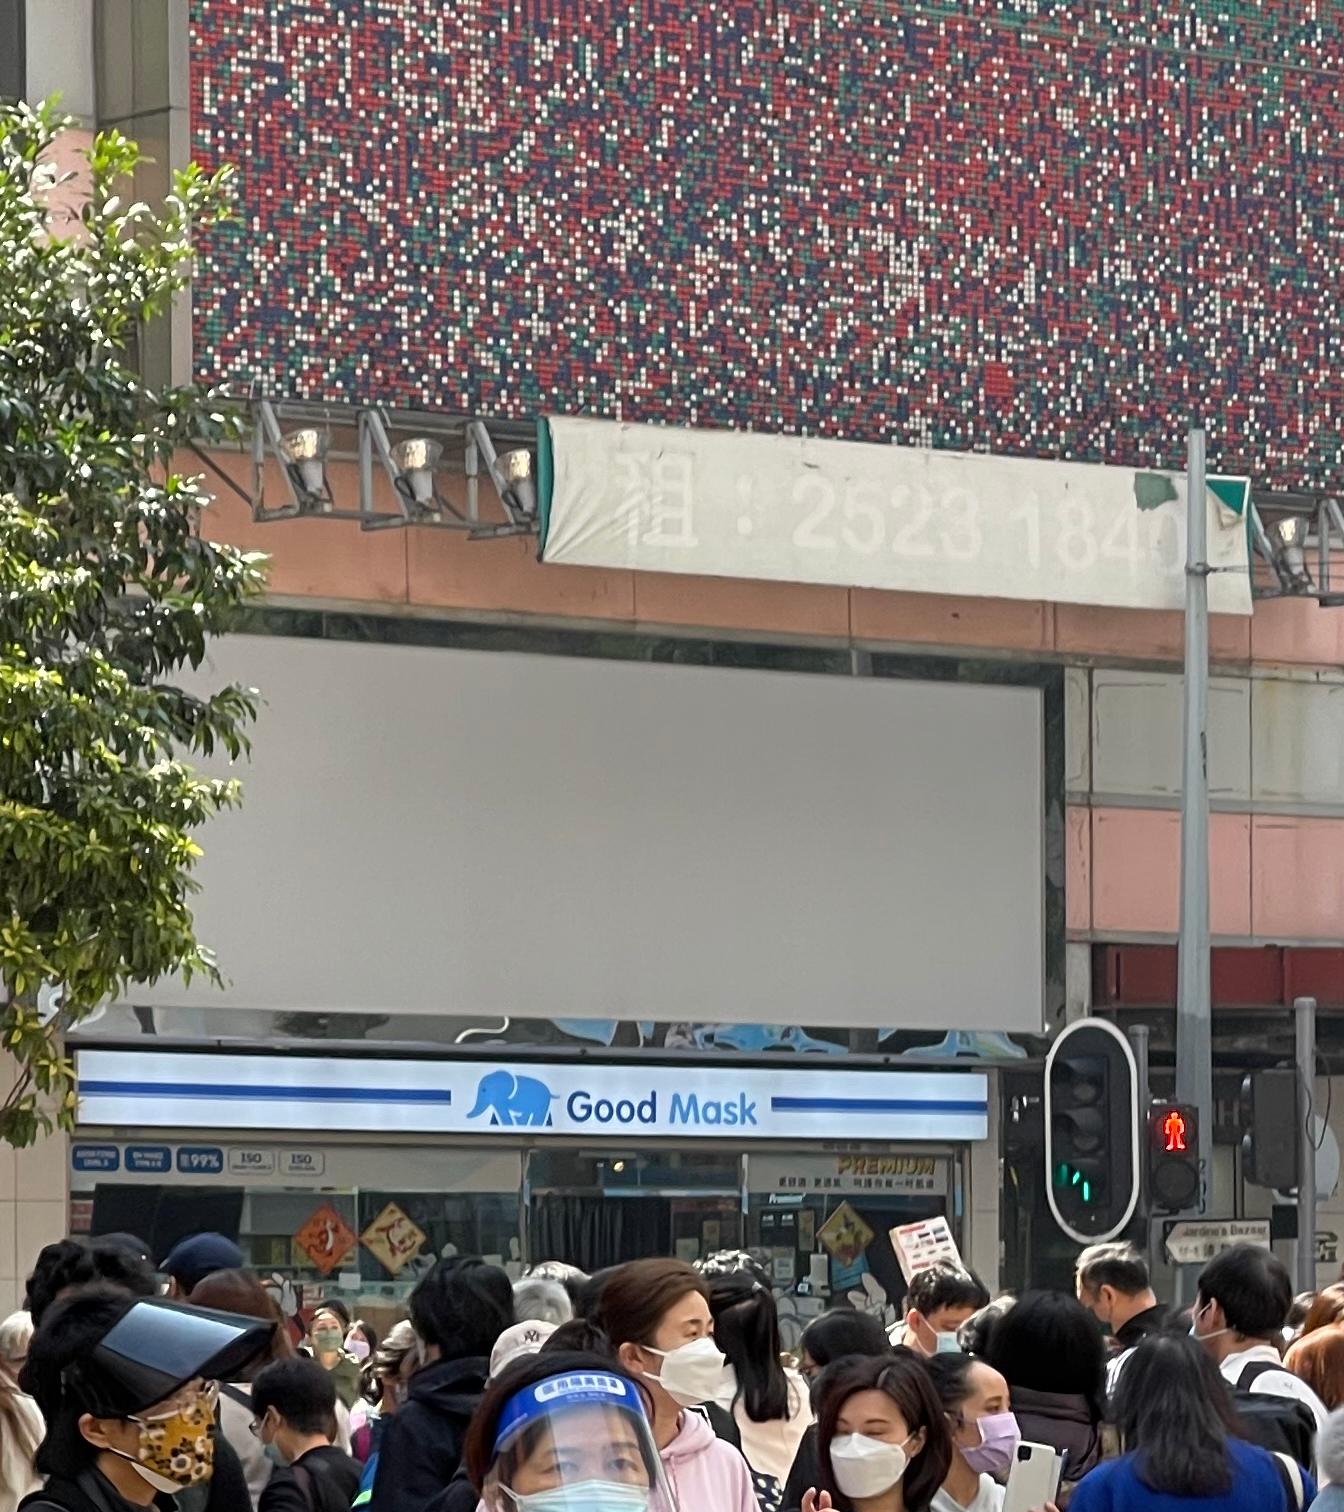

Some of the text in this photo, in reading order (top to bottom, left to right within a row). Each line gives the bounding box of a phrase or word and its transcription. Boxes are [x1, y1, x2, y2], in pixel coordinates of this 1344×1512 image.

[792, 473, 982, 564] 2523
[566, 1090, 757, 1126] Good Mask
[837, 1154, 937, 1176] PREMIUM
